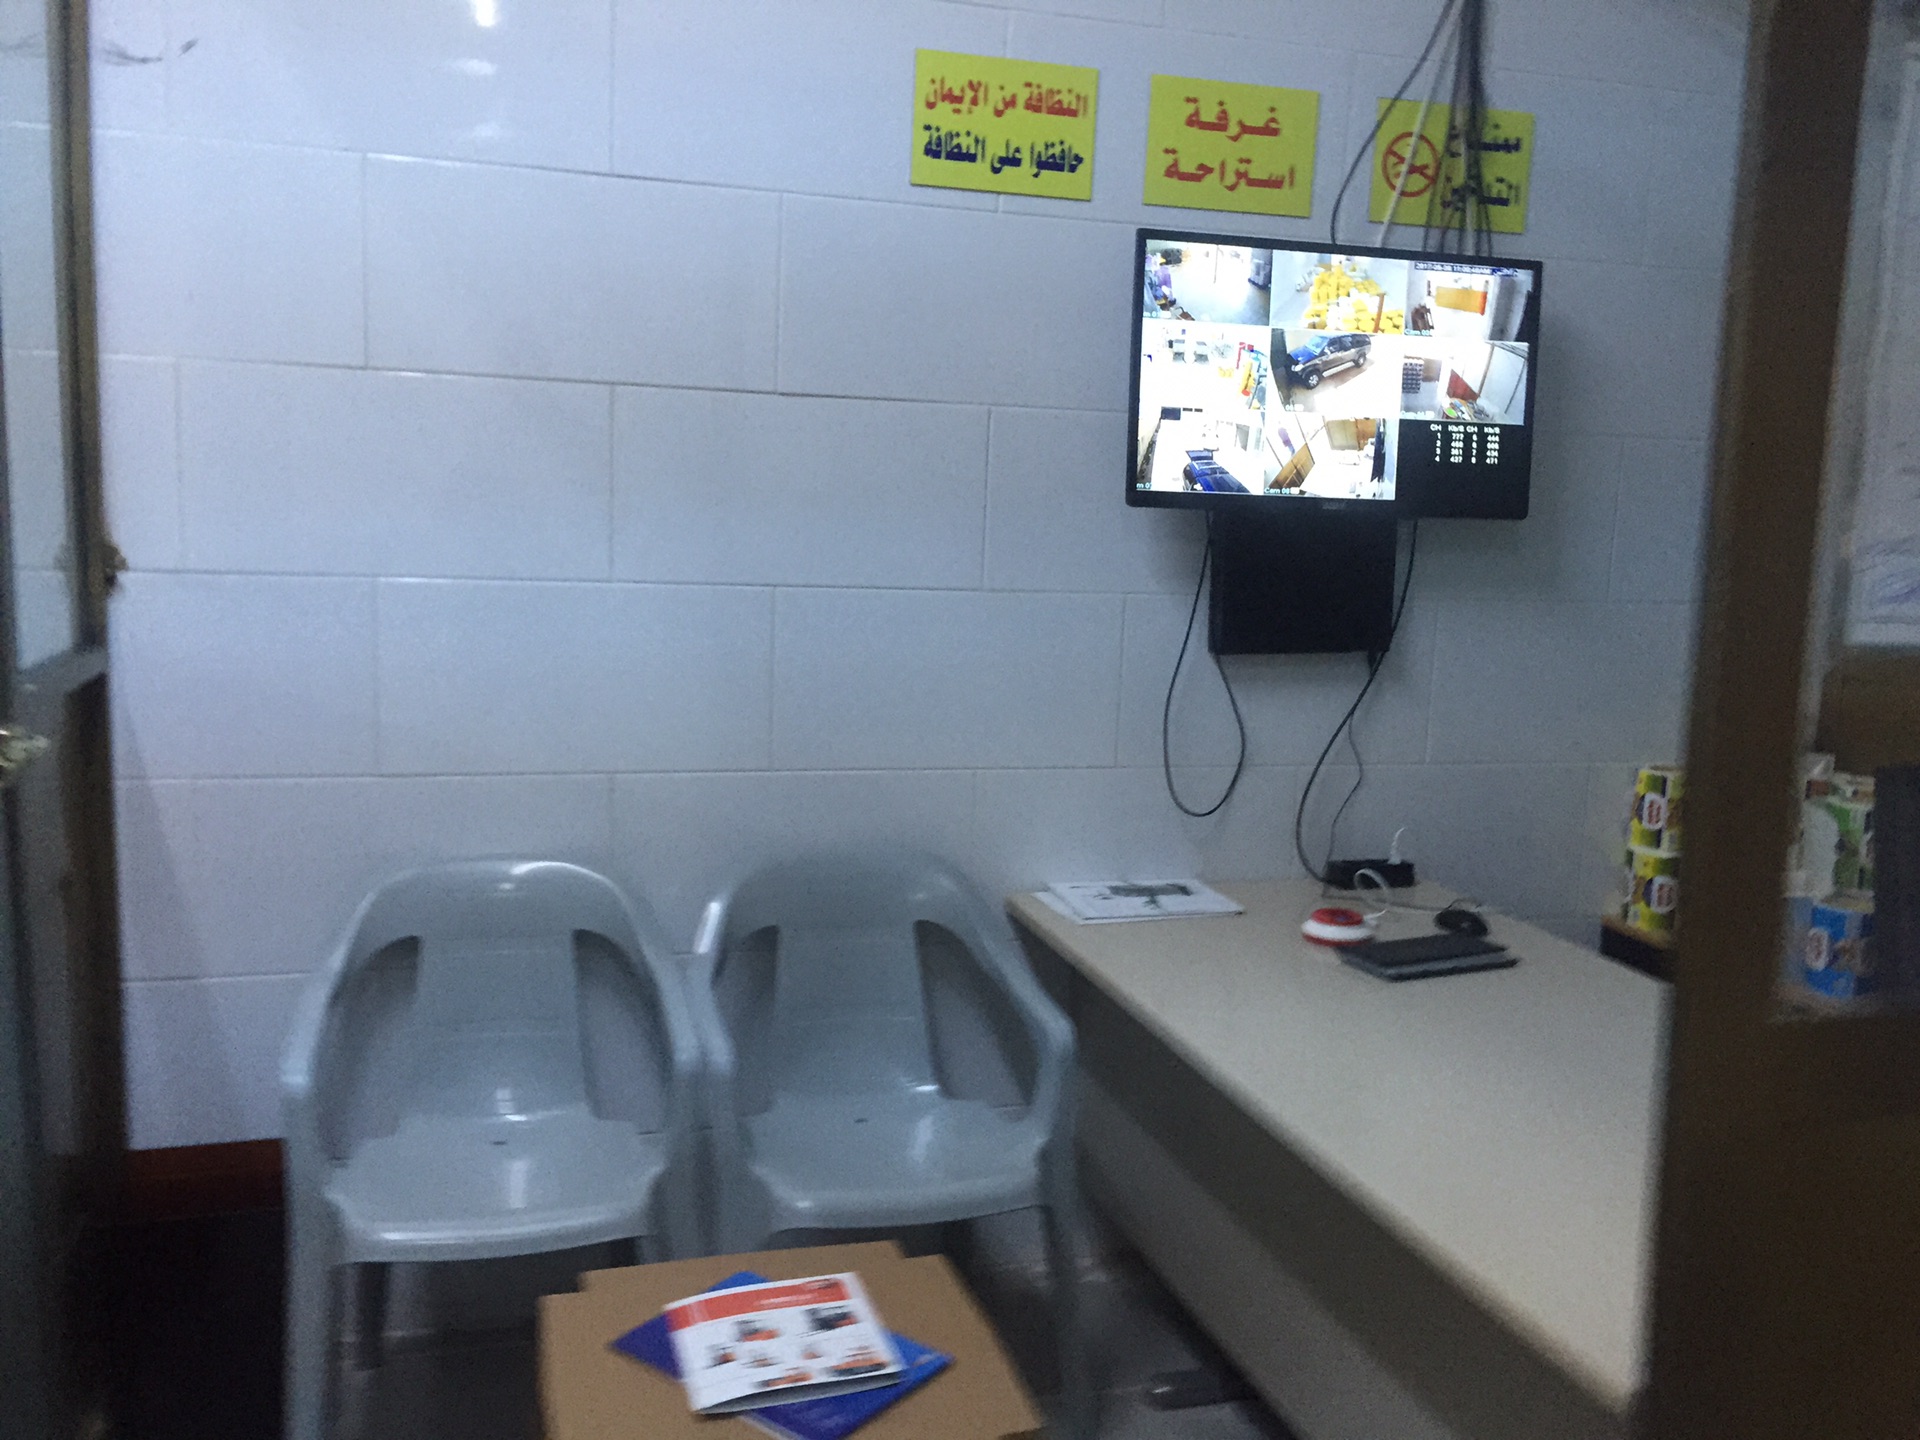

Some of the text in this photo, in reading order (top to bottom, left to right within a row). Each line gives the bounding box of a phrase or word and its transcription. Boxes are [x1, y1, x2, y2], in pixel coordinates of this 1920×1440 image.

[925, 76, 1088, 117] النظافة من الإيمان
[1184, 97, 1280, 142] غرفة
[923, 124, 1084, 178] حافظوا على النظافة
[1163, 148, 1296, 192] استراحة
